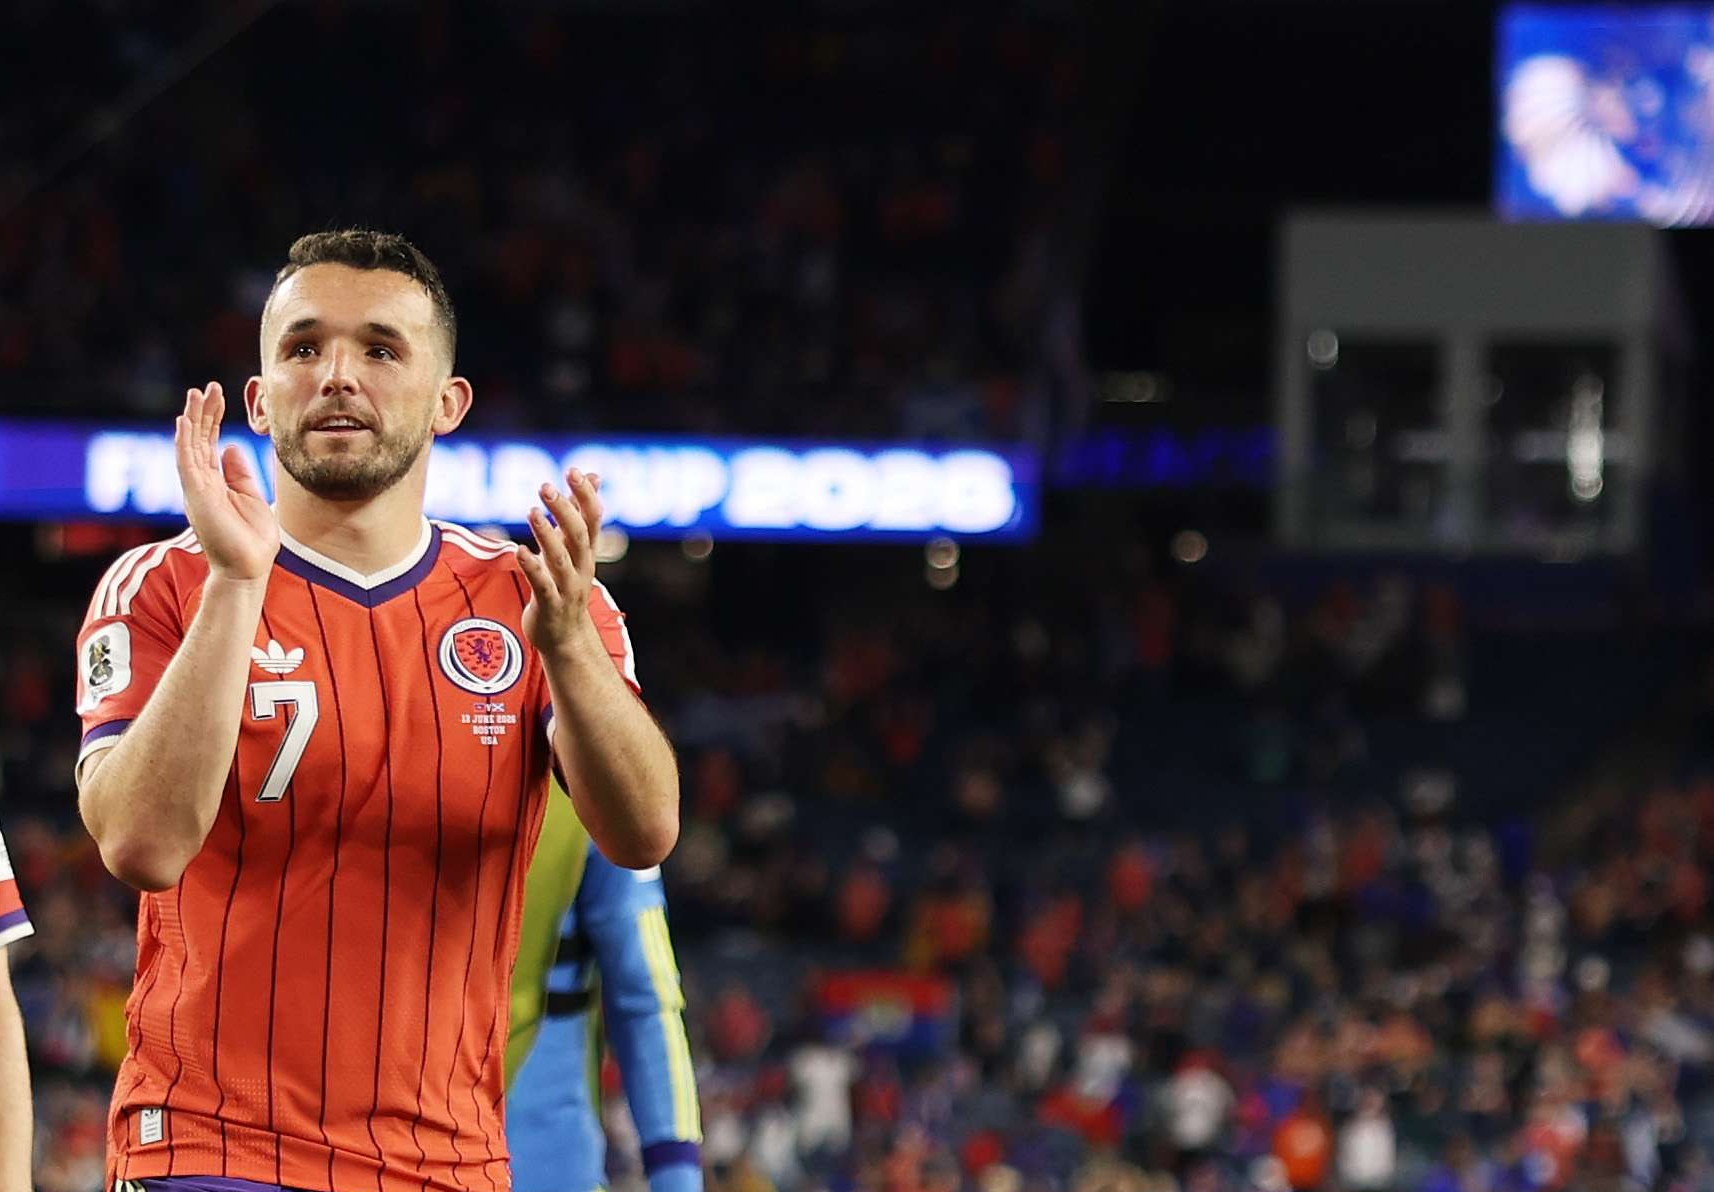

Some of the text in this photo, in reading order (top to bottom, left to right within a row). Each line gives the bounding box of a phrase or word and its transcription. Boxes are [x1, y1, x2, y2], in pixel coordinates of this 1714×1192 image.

[726, 446, 1018, 534] 2026
[249, 680, 319, 803] 7
[480, 735, 499, 745] USA
